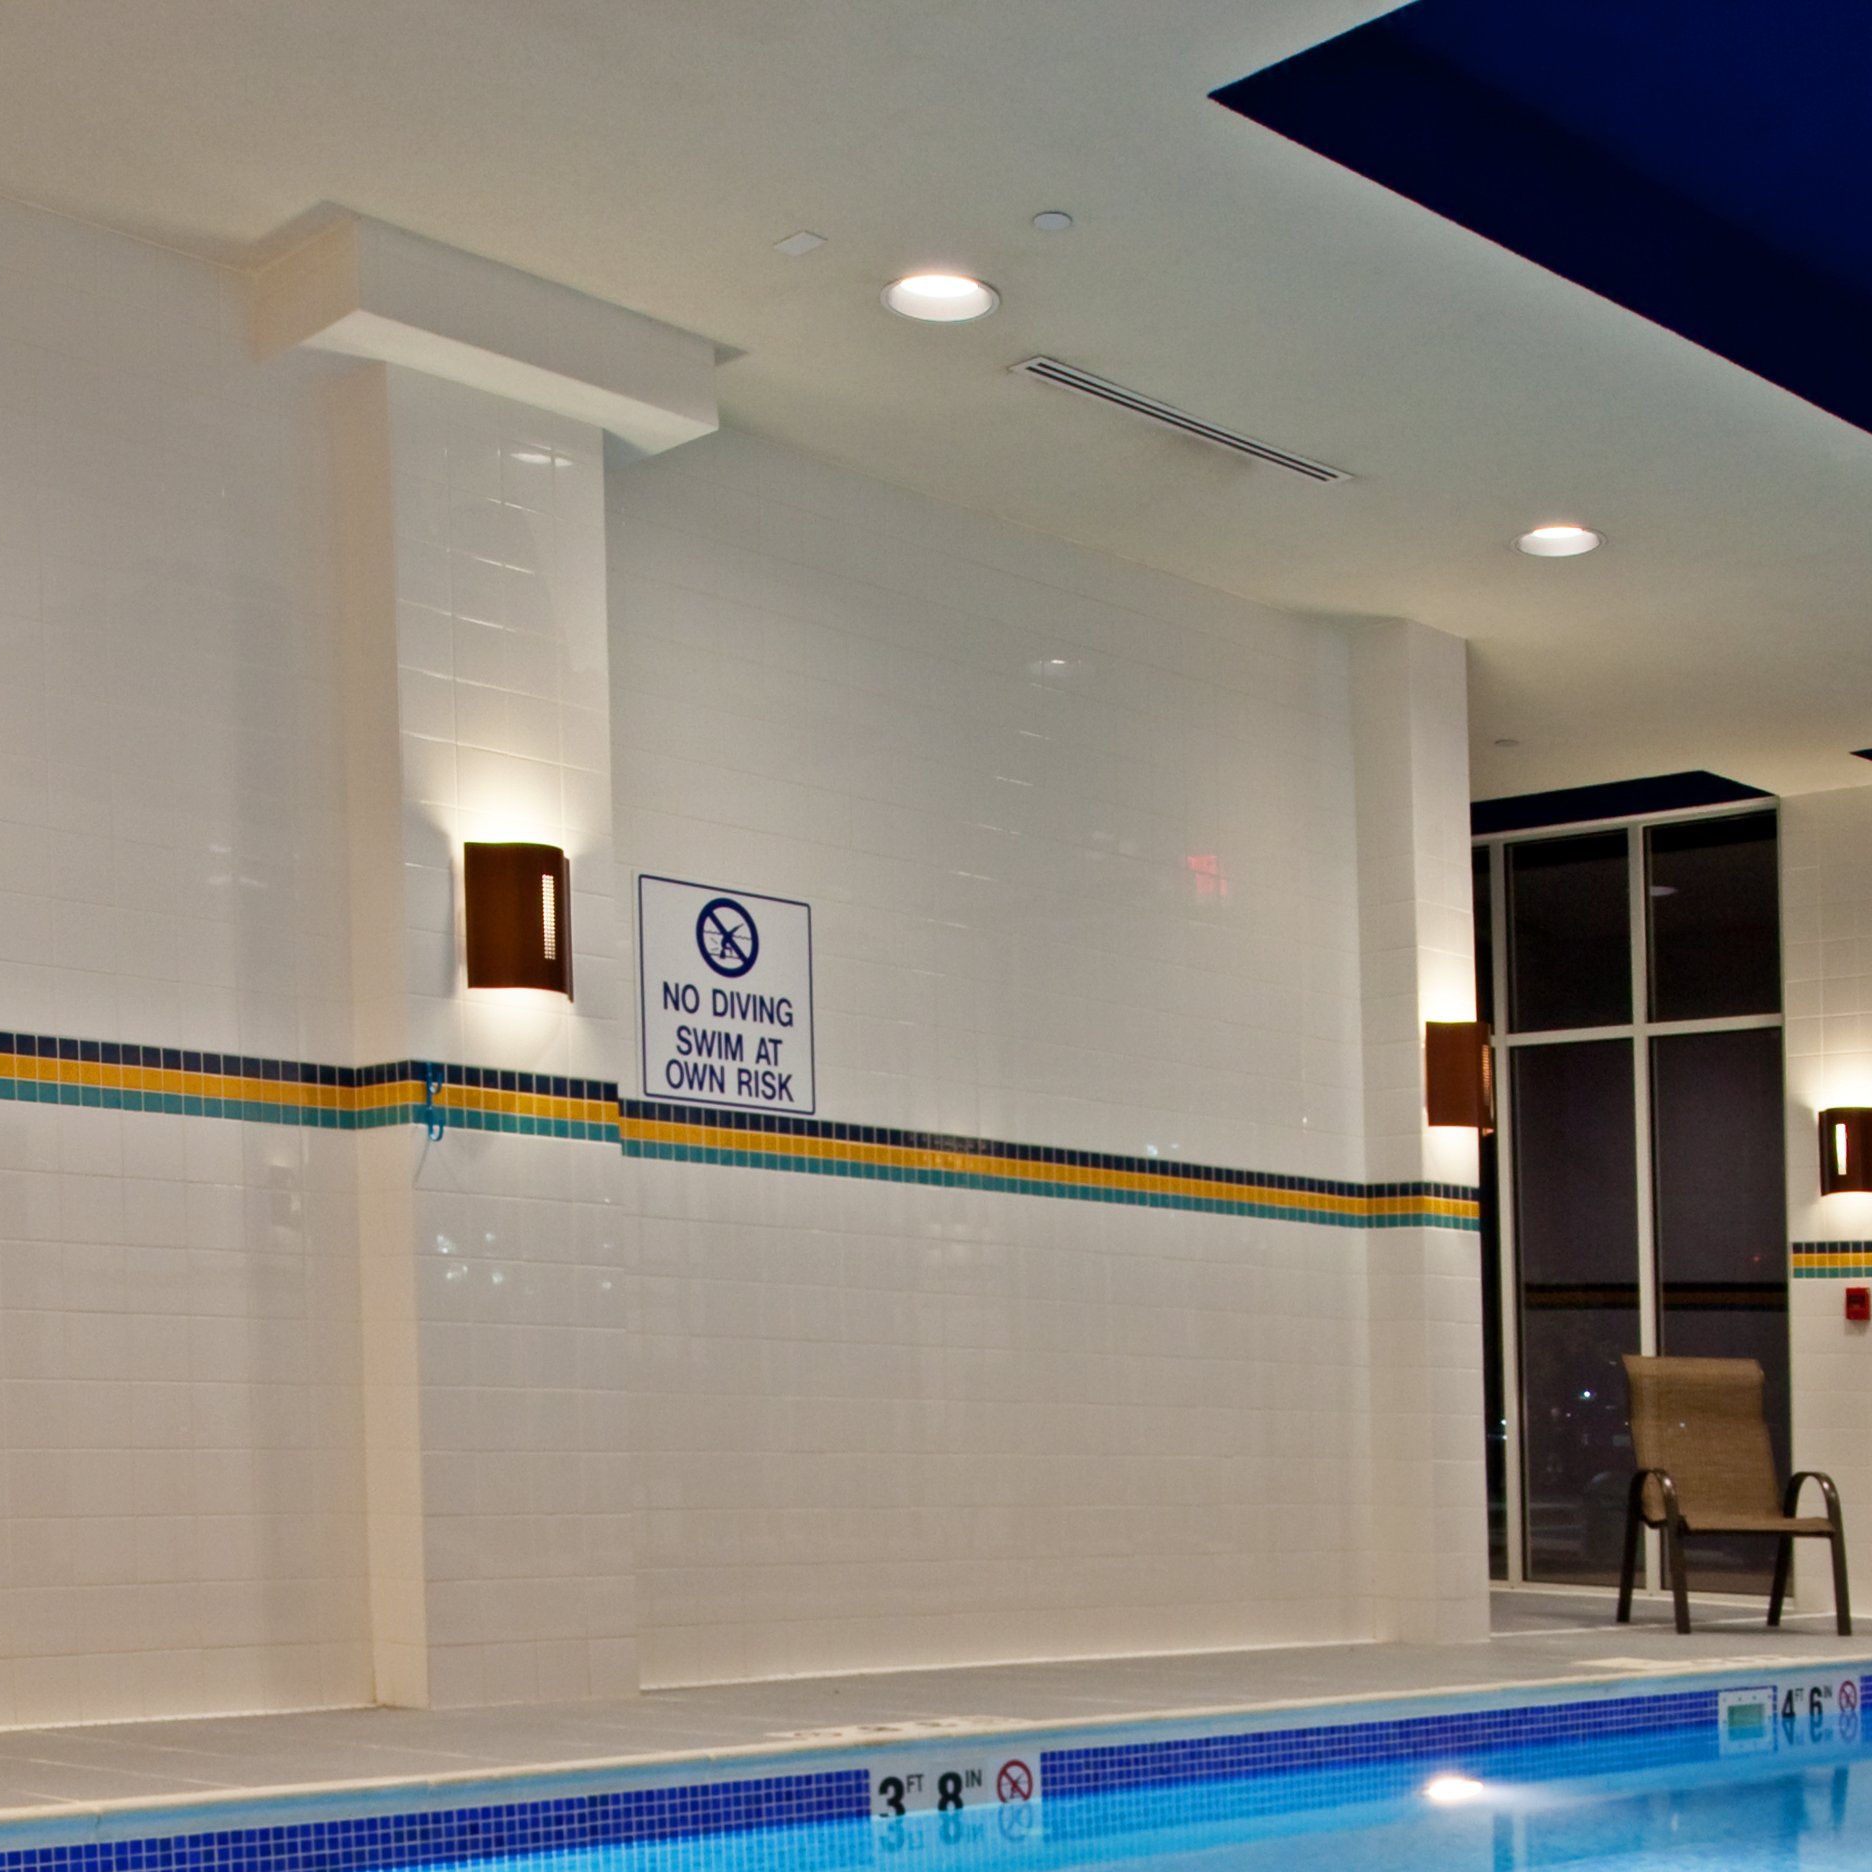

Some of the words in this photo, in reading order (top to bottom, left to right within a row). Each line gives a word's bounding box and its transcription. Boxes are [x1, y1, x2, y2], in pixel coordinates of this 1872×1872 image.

[662, 980, 701, 1015] NO
[711, 988, 794, 1028] DIVING
[676, 1024, 744, 1063] SWIM
[755, 1036, 783, 1067] AT
[665, 1058, 726, 1094] OWN
[737, 1067, 795, 1103] RISK
[1782, 1689, 1795, 1718] 4
[1809, 1687, 1822, 1715] 6
[879, 1776, 905, 1818] 3
[906, 1774, 924, 1793] FT
[938, 1772, 963, 1812] 8
[965, 1769, 982, 1788] IN
